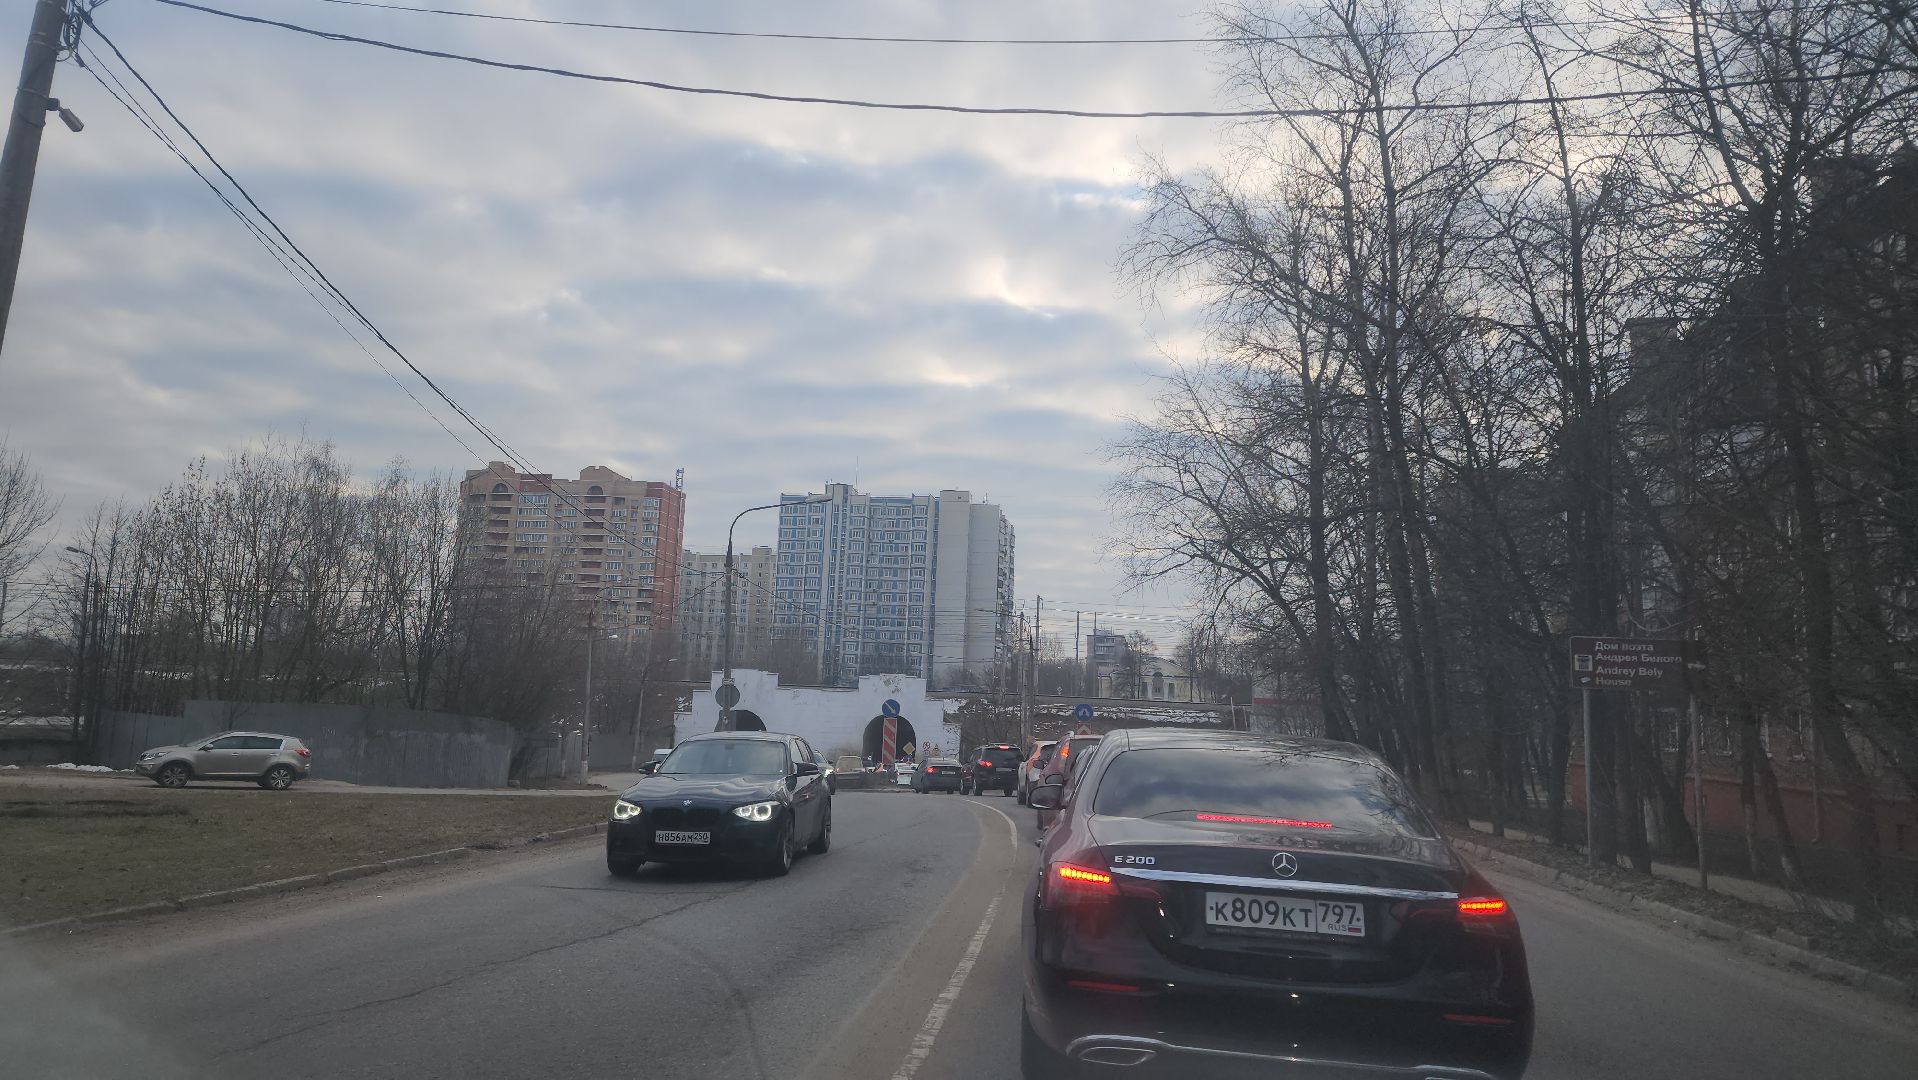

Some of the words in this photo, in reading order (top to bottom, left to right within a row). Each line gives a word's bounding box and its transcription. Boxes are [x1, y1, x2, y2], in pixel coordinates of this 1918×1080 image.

[1595, 641, 1619, 651] Дом
[1595, 652, 1638, 663] Андрея
[1596, 666, 1636, 677] Andrey
[1638, 667, 1663, 678] Bely
[1595, 678, 1632, 686] House
[1114, 855, 1123, 864] E
[1125, 855, 1155, 865] 200
[1318, 902, 1357, 925] 797
[1327, 923, 1347, 932] RUS
